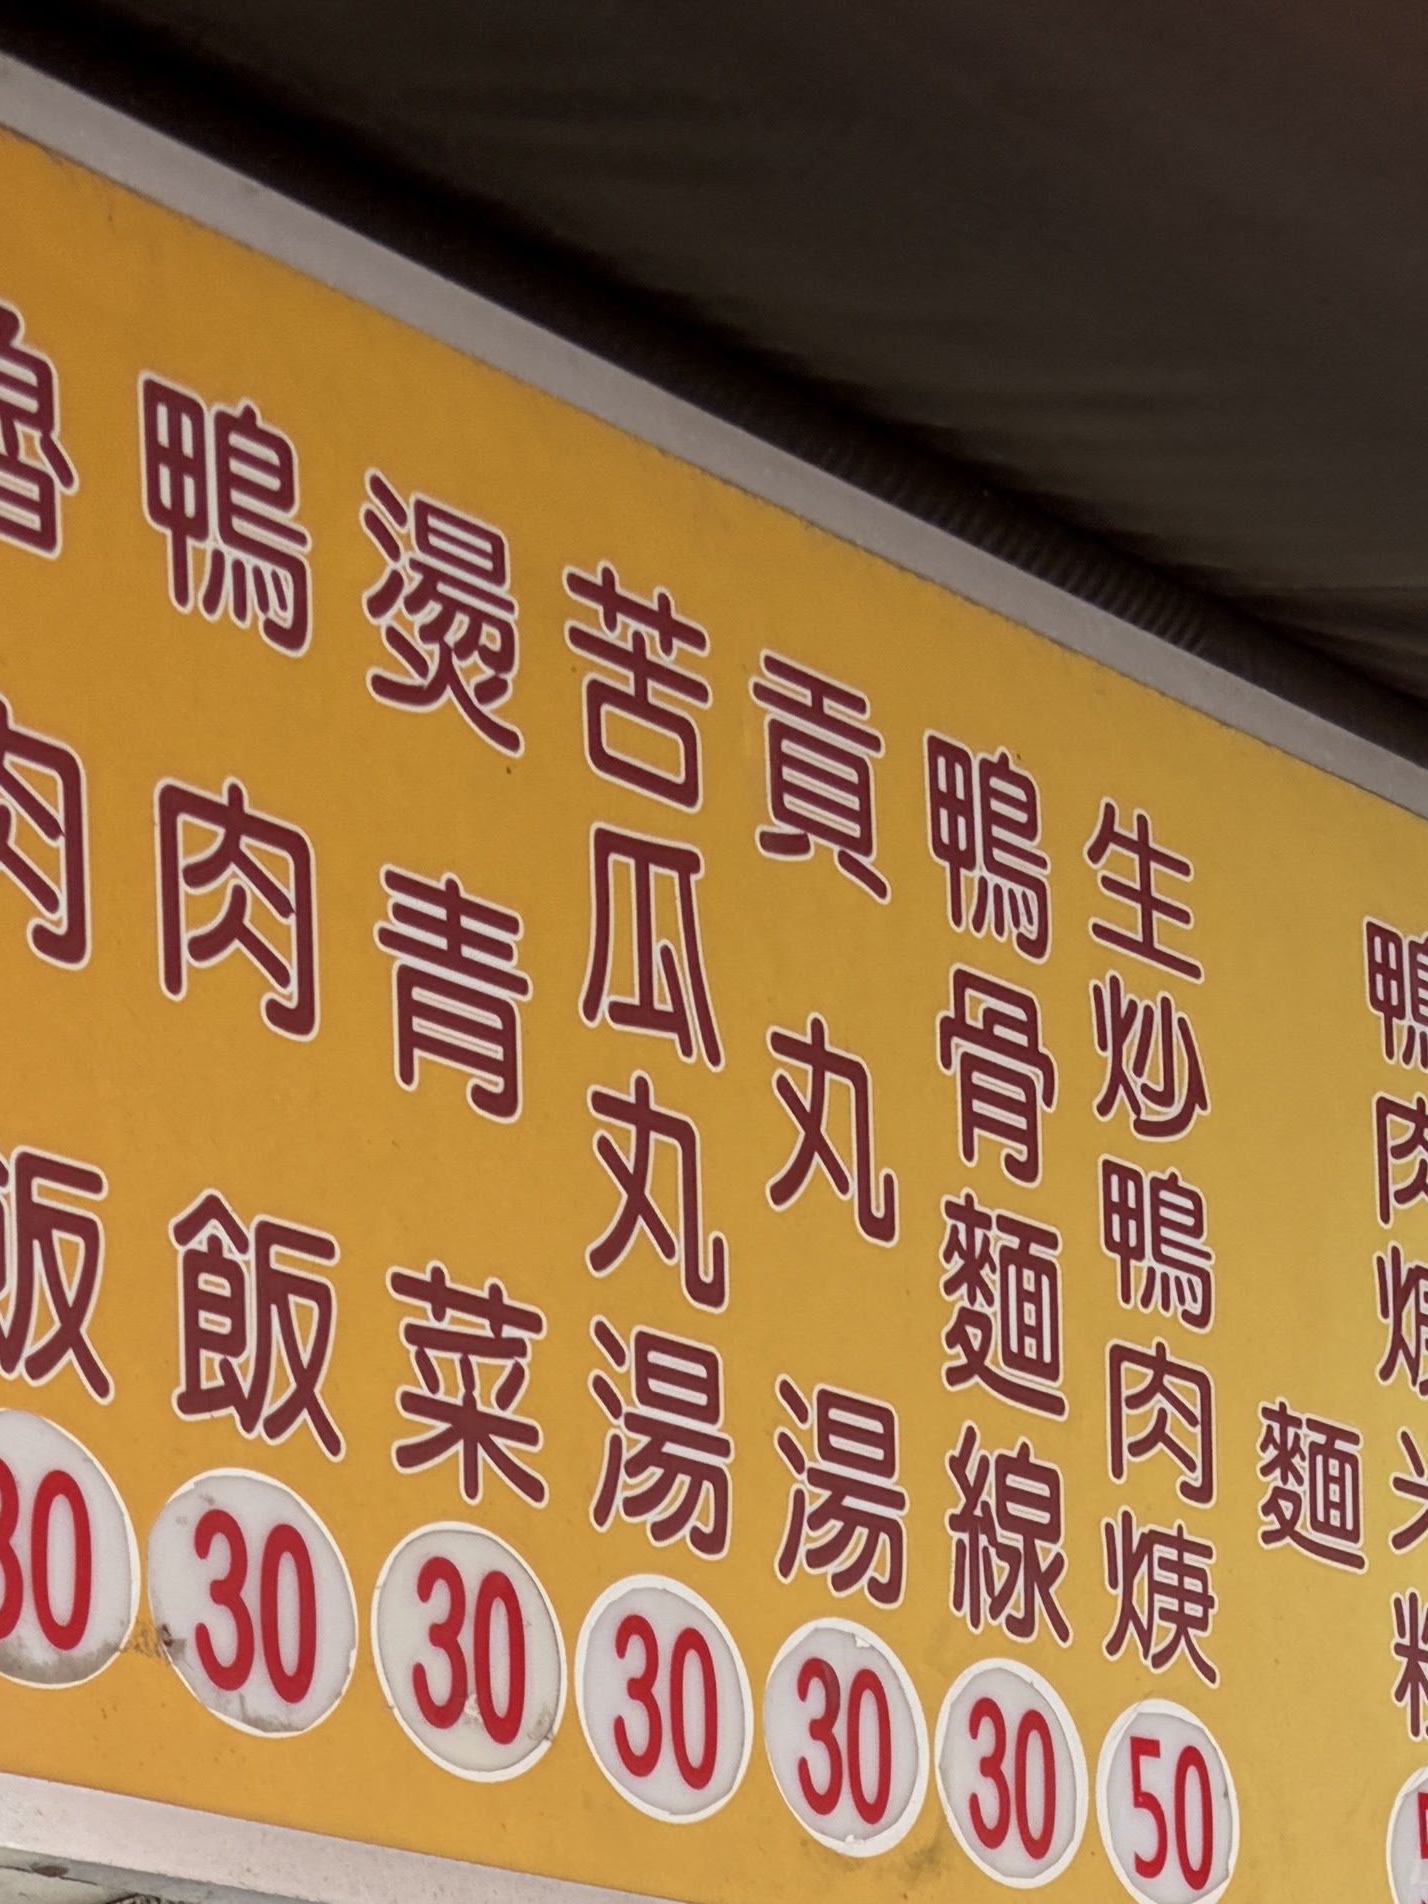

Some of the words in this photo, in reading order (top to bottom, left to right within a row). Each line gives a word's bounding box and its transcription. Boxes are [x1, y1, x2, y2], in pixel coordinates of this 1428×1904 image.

[140, 374, 344, 1461] 鴨肉飯
[361, 470, 549, 1508] 燙青菜
[564, 562, 733, 1559] 苦瓜丸湯
[752, 650, 908, 1609] 貢丸湯
[924, 730, 1072, 1648] 鴨骨麵線
[194, 1508, 317, 1705] 30
[413, 1556, 527, 1745] 30
[613, 1612, 718, 1791] 30
[797, 1657, 892, 1825] 30
[968, 1697, 1056, 1861] 30
[1128, 1736, 1213, 1891] 50
[1258, 1396, 1367, 1573] 麵
